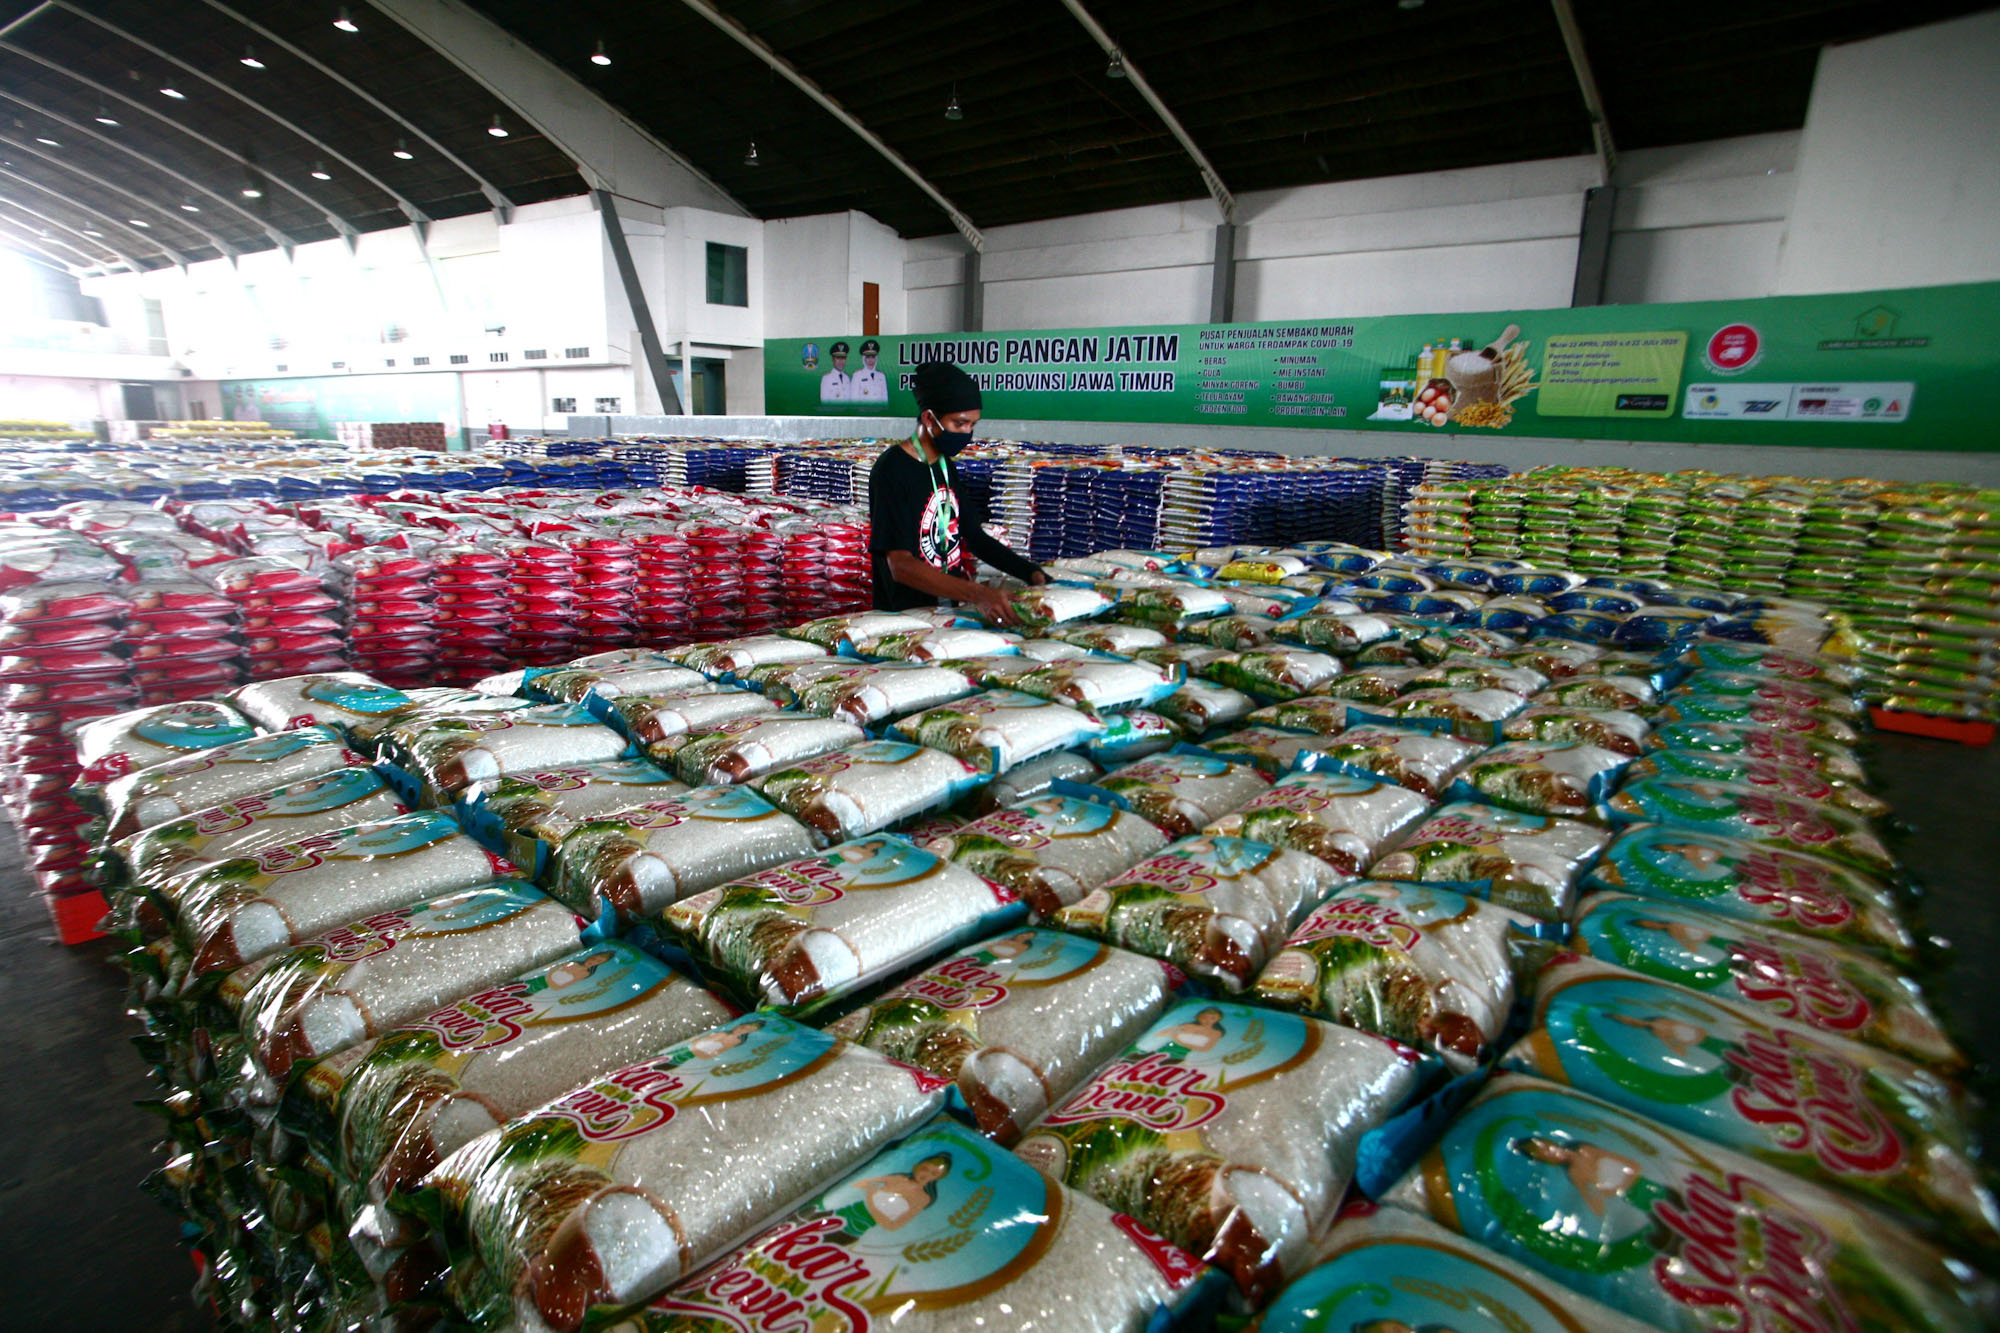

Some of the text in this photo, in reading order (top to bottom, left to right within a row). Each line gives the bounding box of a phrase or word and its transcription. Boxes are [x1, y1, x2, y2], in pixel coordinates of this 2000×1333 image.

[1200, 326, 1354, 340] PUSAT PENJUALAN SEMBAKO MURAH
[1200, 342, 1225, 350] UNTUK
[1227, 341, 1256, 350] WARGA
[1258, 340, 1308, 349] TERDAMPAK
[899, 335, 1178, 365] LUMBUNG PANGAN JATIM
[1204, 357, 1227, 366] BERAS
[1280, 356, 1317, 364] MINUMAN
[1203, 369, 1221, 377] GULA
[1278, 368, 1326, 377] MIE INSTANT
[995, 373, 1066, 391] PROVINSI
[1070, 373, 1114, 391] JAWA
[1120, 372, 1174, 391] TIMUR
[1202, 381, 1259, 390] MINYAK GORENG
[1278, 381, 1305, 390] BUMBU
[1202, 393, 1244, 401] TELUR AYAM
[1276, 394, 1334, 403] BAWANG PUTIH
[1200, 404, 1247, 414] FROZEN FOOD
[1275, 406, 1305, 415] PRODUK
[1085, 1053, 1220, 1110] ekar
